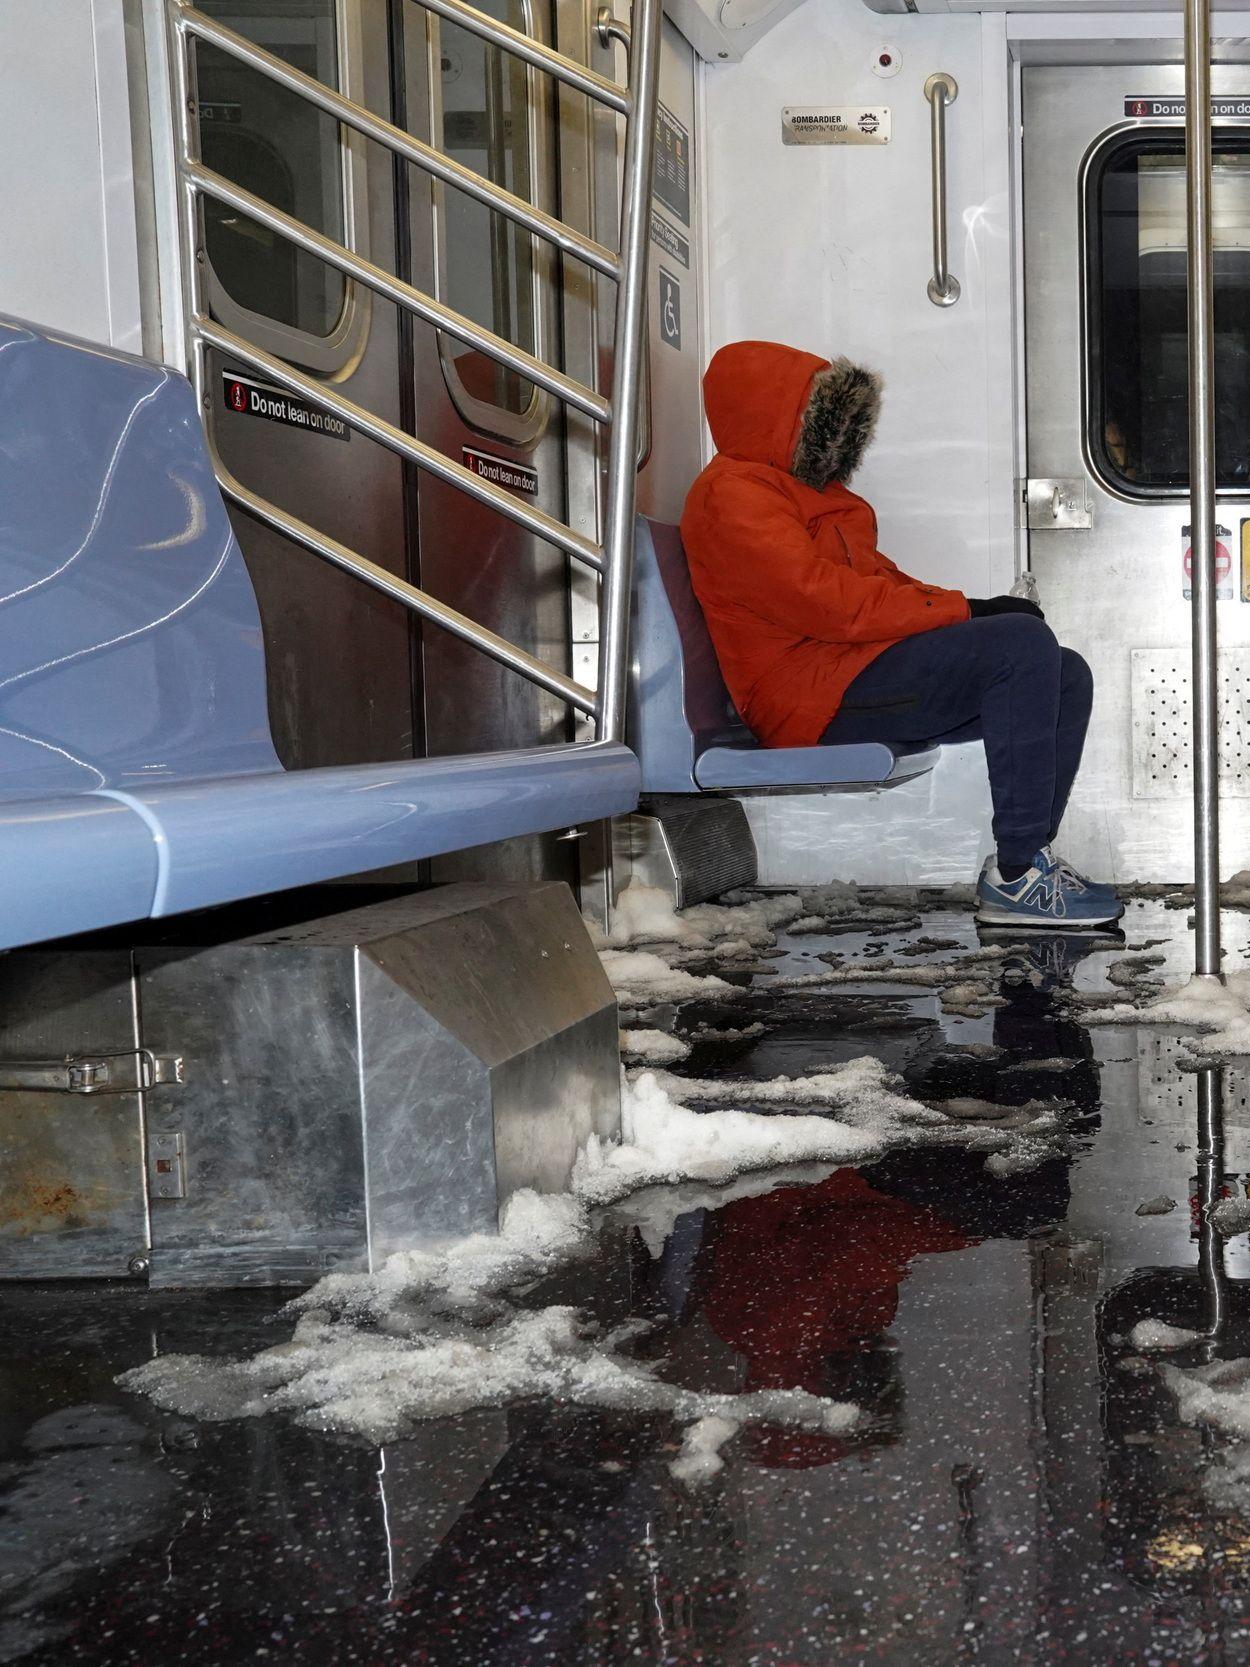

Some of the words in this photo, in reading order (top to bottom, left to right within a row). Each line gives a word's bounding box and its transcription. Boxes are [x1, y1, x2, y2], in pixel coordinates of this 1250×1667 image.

[1152, 103, 1170, 114] Do
[1172, 105, 1186, 114] no
[1220, 105, 1235, 114] on
[250, 391, 267, 413] Do
[268, 400, 286, 419] not
[288, 402, 310, 425] lean
[310, 413, 323, 428] on
[324, 414, 346, 435] door
[478, 460, 489, 476] Do
[489, 467, 500, 481] not
[500, 467, 514, 485] lean
[513, 475, 522, 488] on
[521, 475, 536, 492] door
